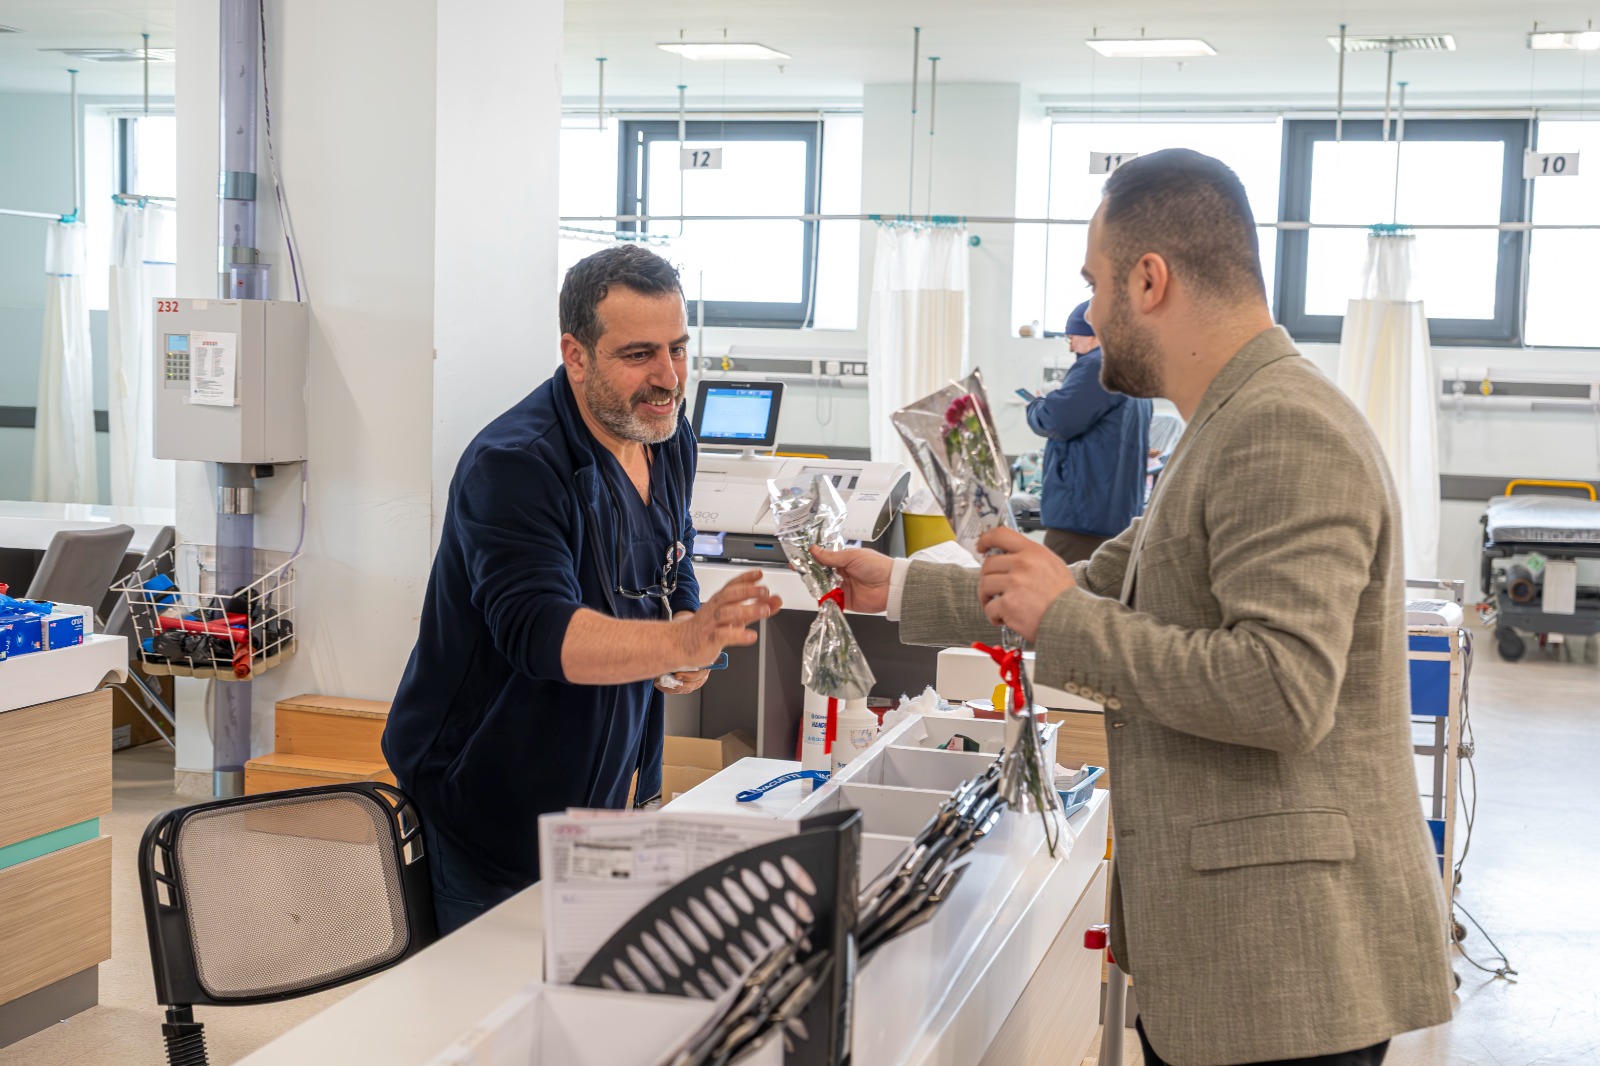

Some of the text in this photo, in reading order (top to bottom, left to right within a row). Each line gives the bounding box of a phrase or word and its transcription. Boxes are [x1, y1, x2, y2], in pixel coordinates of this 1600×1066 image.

[692, 151, 711, 167] 12
[1542, 156, 1566, 173] 10
[157, 301, 179, 312] 232
